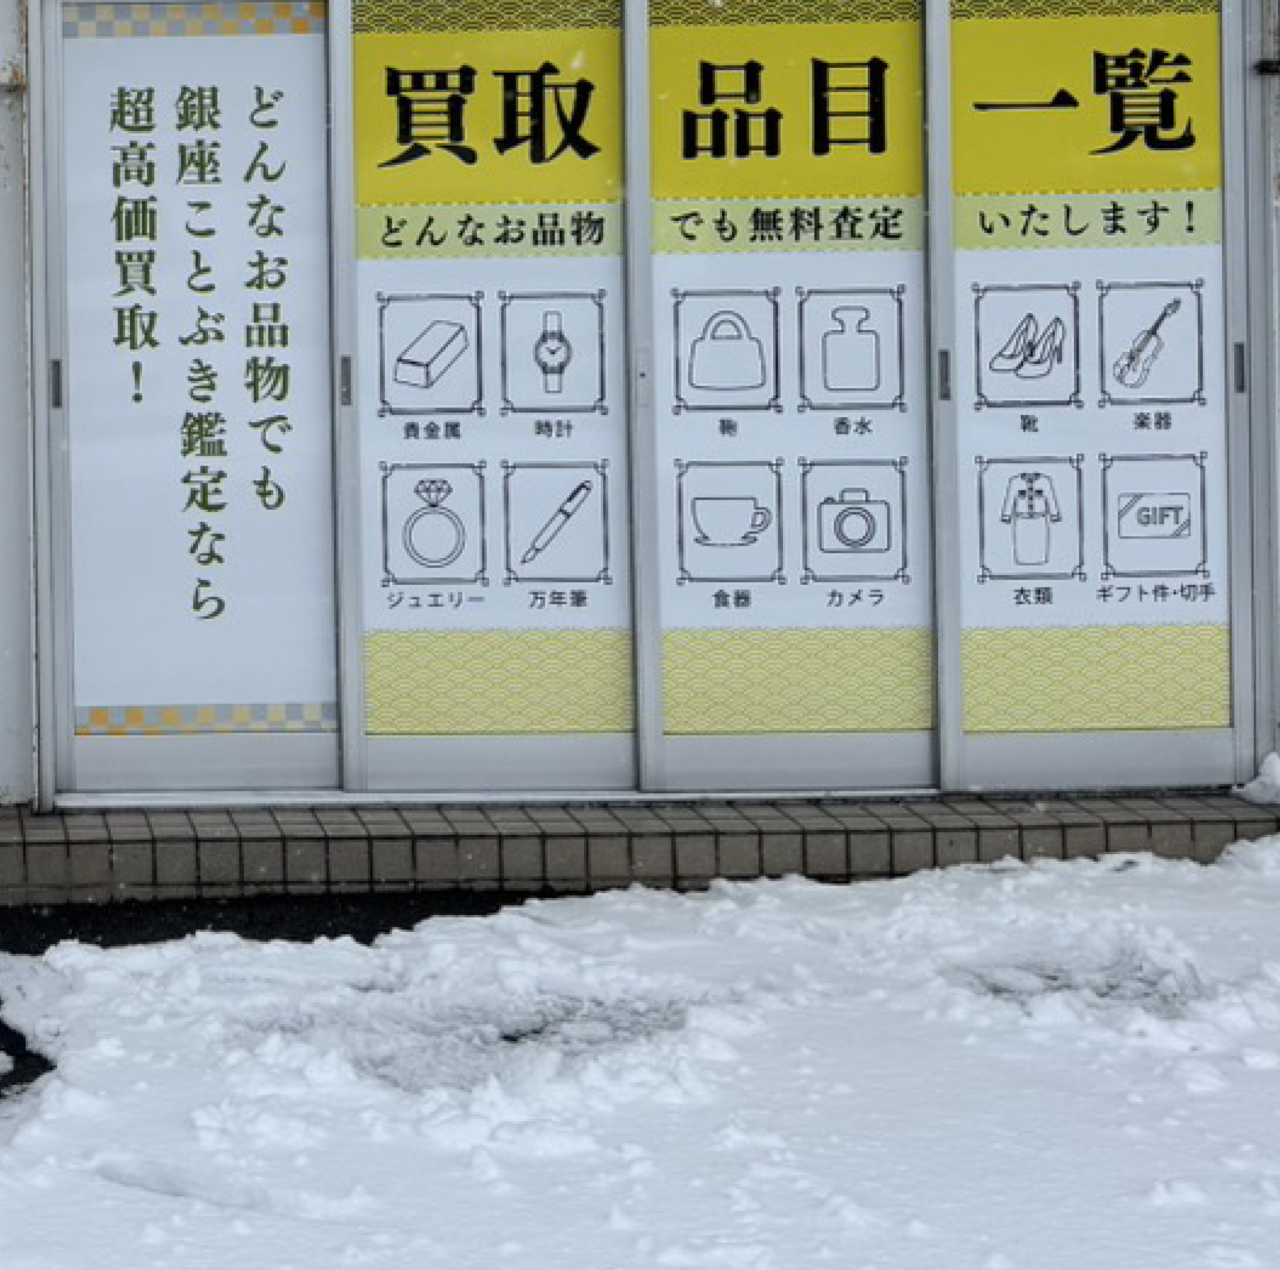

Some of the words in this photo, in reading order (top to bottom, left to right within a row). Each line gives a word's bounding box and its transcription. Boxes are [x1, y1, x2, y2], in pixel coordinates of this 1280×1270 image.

[375, 58, 603, 170] 買取
[680, 54, 890, 162] 品目
[970, 45, 1198, 156] 一覧
[378, 208, 608, 251] どんなお品物
[668, 202, 908, 245] でも無料査定
[976, 198, 1198, 238] いたします！
[107, 84, 162, 408] 超高価買取！
[242, 82, 293, 514] どんなお品物でも
[173, 84, 229, 622] 銀座ことぶき鑑定なら
[403, 420, 463, 440] 貴金属
[533, 418, 575, 438] 時計
[833, 415, 875, 435] 香水
[1133, 411, 1174, 432] 楽器
[1136, 506, 1185, 526] GIFT
[386, 592, 486, 610] ジュエリー
[527, 588, 588, 609] 万年筆
[710, 588, 752, 610] 食器
[825, 588, 886, 608] カメラ
[1012, 585, 1054, 606] 衣類
